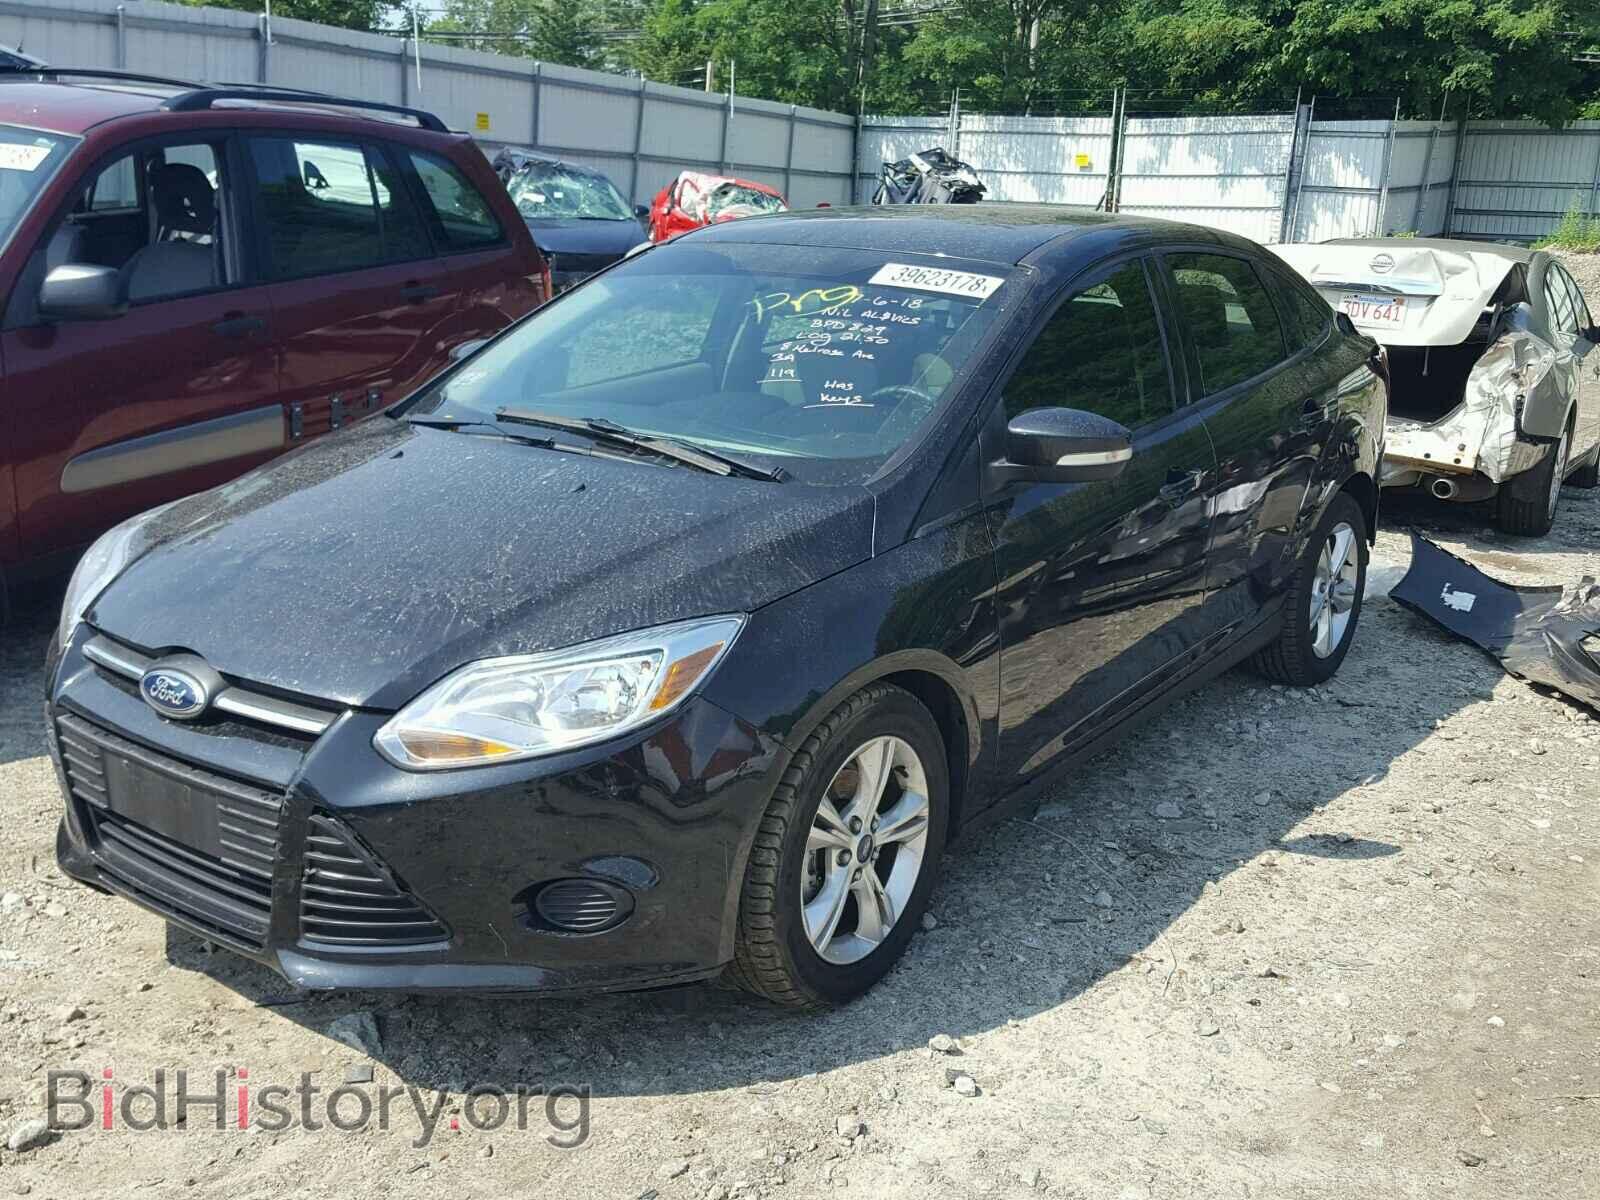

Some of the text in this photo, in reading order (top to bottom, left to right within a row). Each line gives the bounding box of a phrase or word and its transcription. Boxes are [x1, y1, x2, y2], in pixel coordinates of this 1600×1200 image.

[890, 267, 985, 292] 39623178
[1373, 305, 1400, 322] 641
[150, 676, 187, 705] Ford
